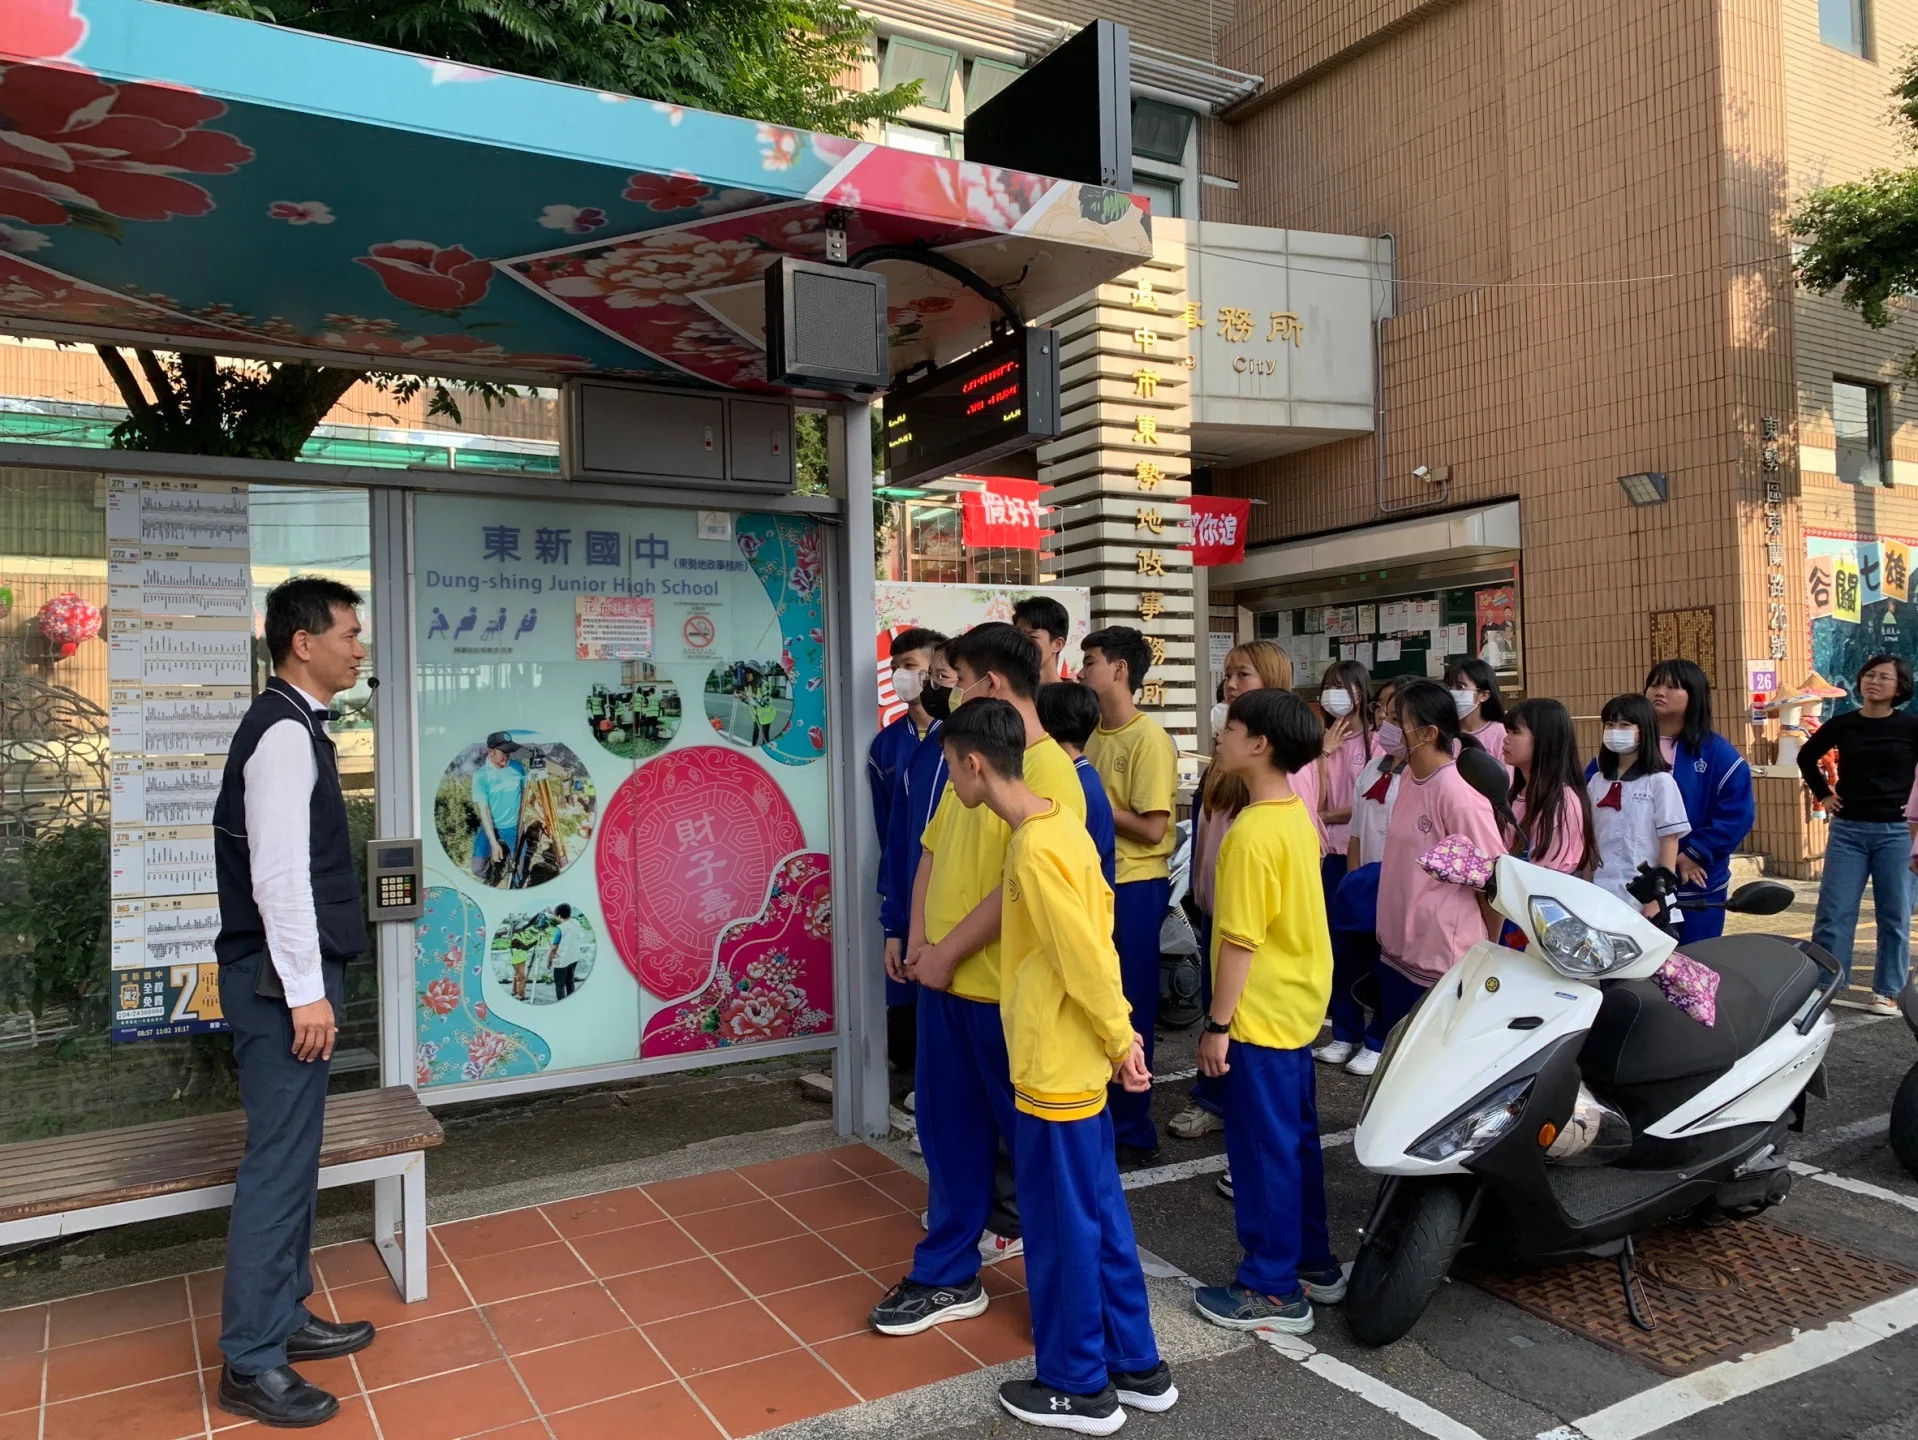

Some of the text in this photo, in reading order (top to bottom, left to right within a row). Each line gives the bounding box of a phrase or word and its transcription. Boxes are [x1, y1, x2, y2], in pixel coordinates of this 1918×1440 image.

[1233, 355, 1277, 376] City
[482, 525, 670, 569] 東新國中
[426, 570, 719, 597] Dung-shing Junior High School
[1757, 673, 1772, 690] 26
[115, 763, 129, 771] 277
[674, 812, 738, 925] 財子壽
[143, 982, 164, 994] 全程
[143, 995, 164, 1007] 免費
